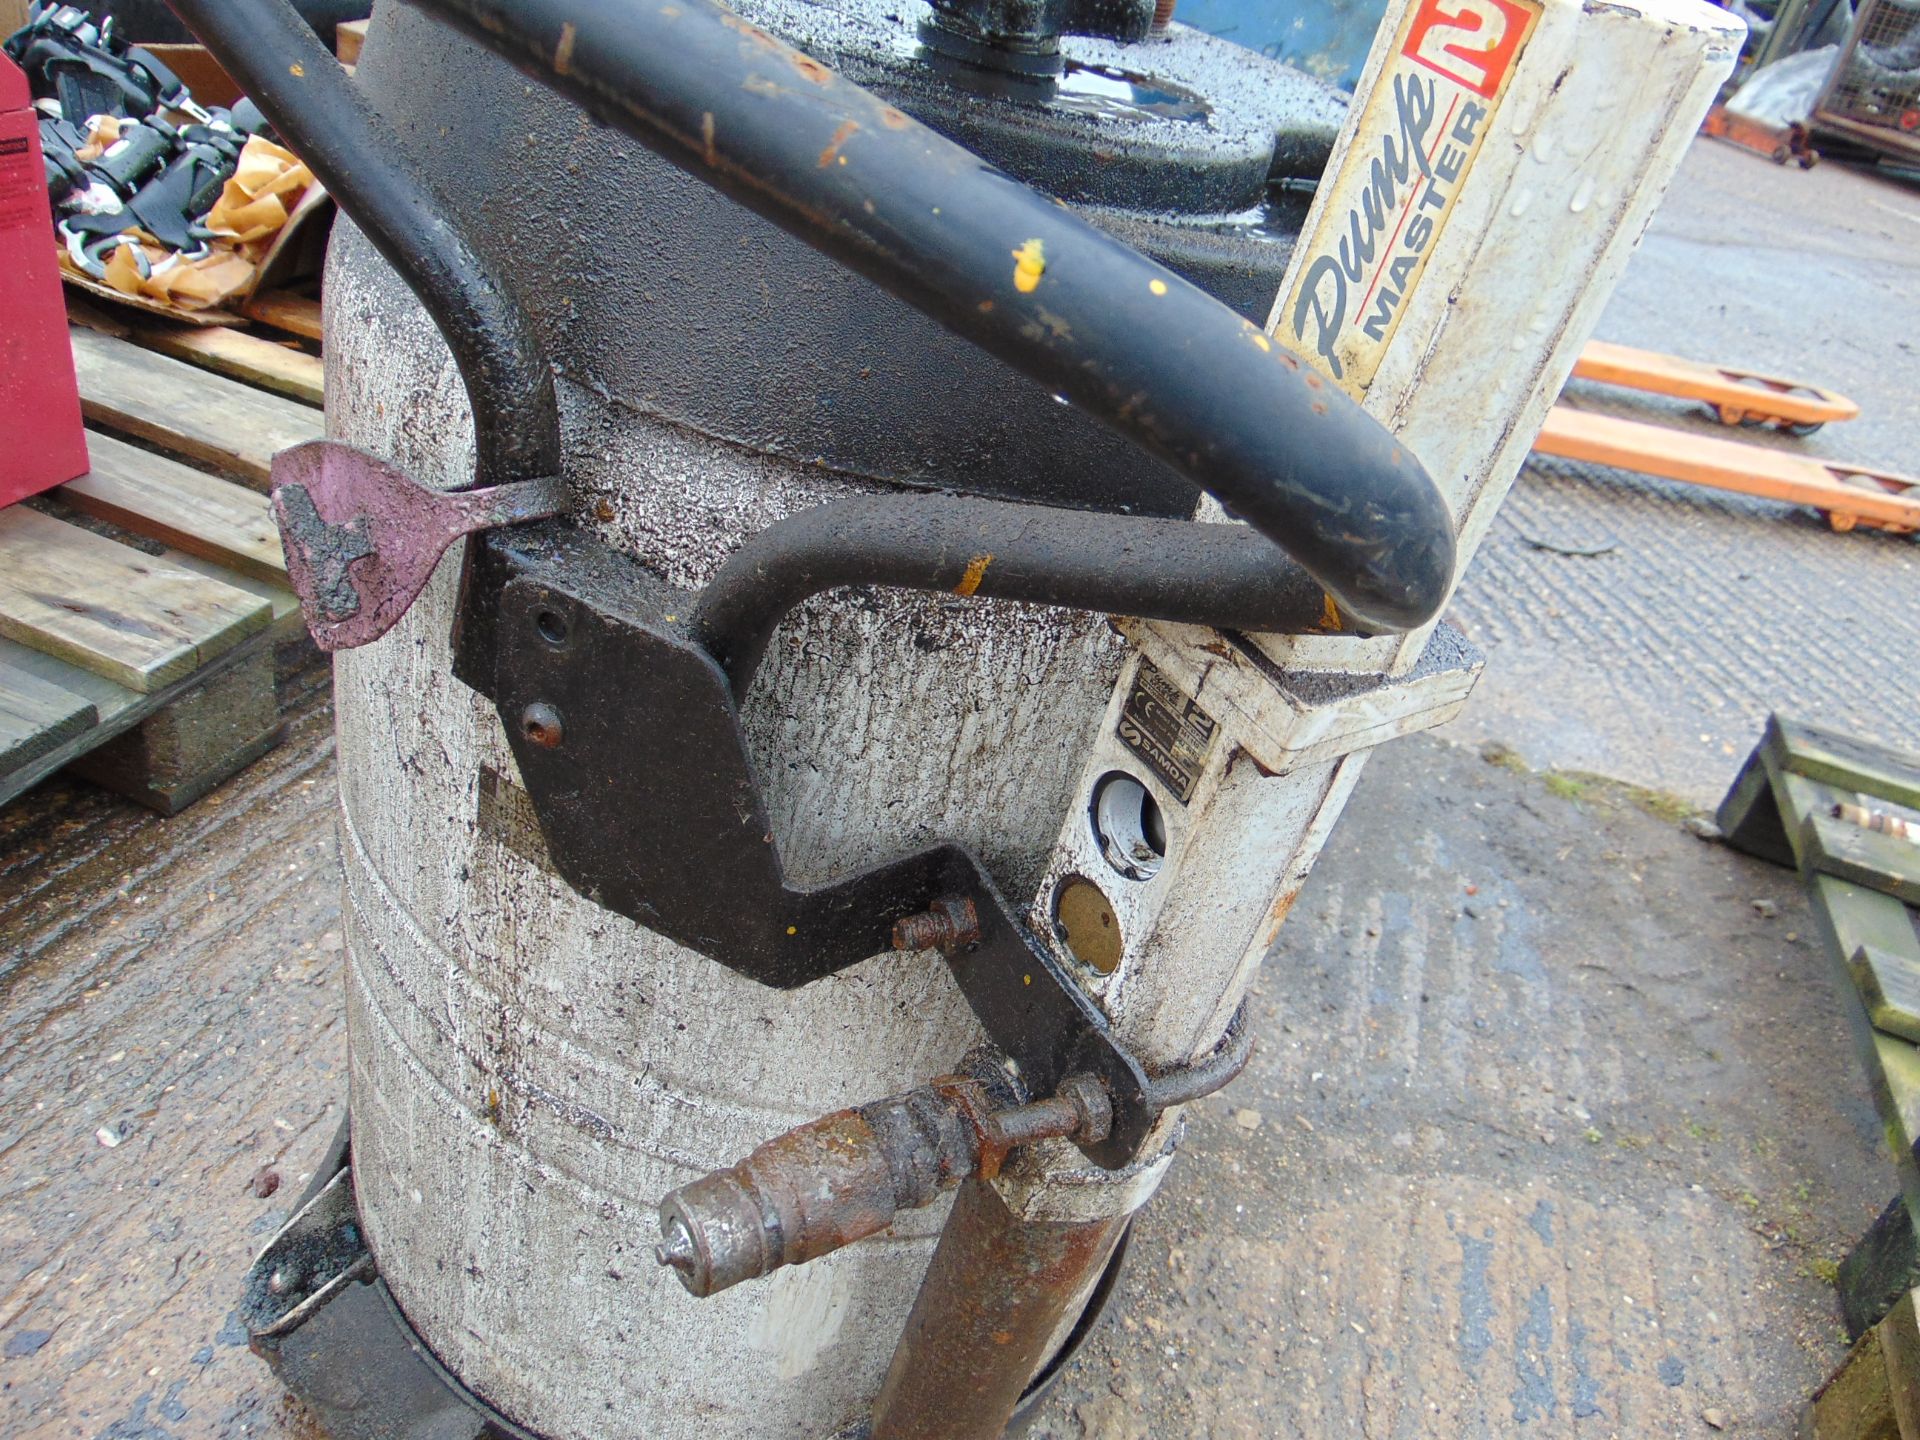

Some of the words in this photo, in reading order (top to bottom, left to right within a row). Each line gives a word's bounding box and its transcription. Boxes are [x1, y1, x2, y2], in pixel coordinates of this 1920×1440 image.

[1417, 0, 1507, 87] 2
[1293, 73, 1435, 380] Pump
[1363, 101, 1487, 342] MASTER
[1140, 737, 1188, 788] SAMOA
[1187, 703, 1213, 736] 2
